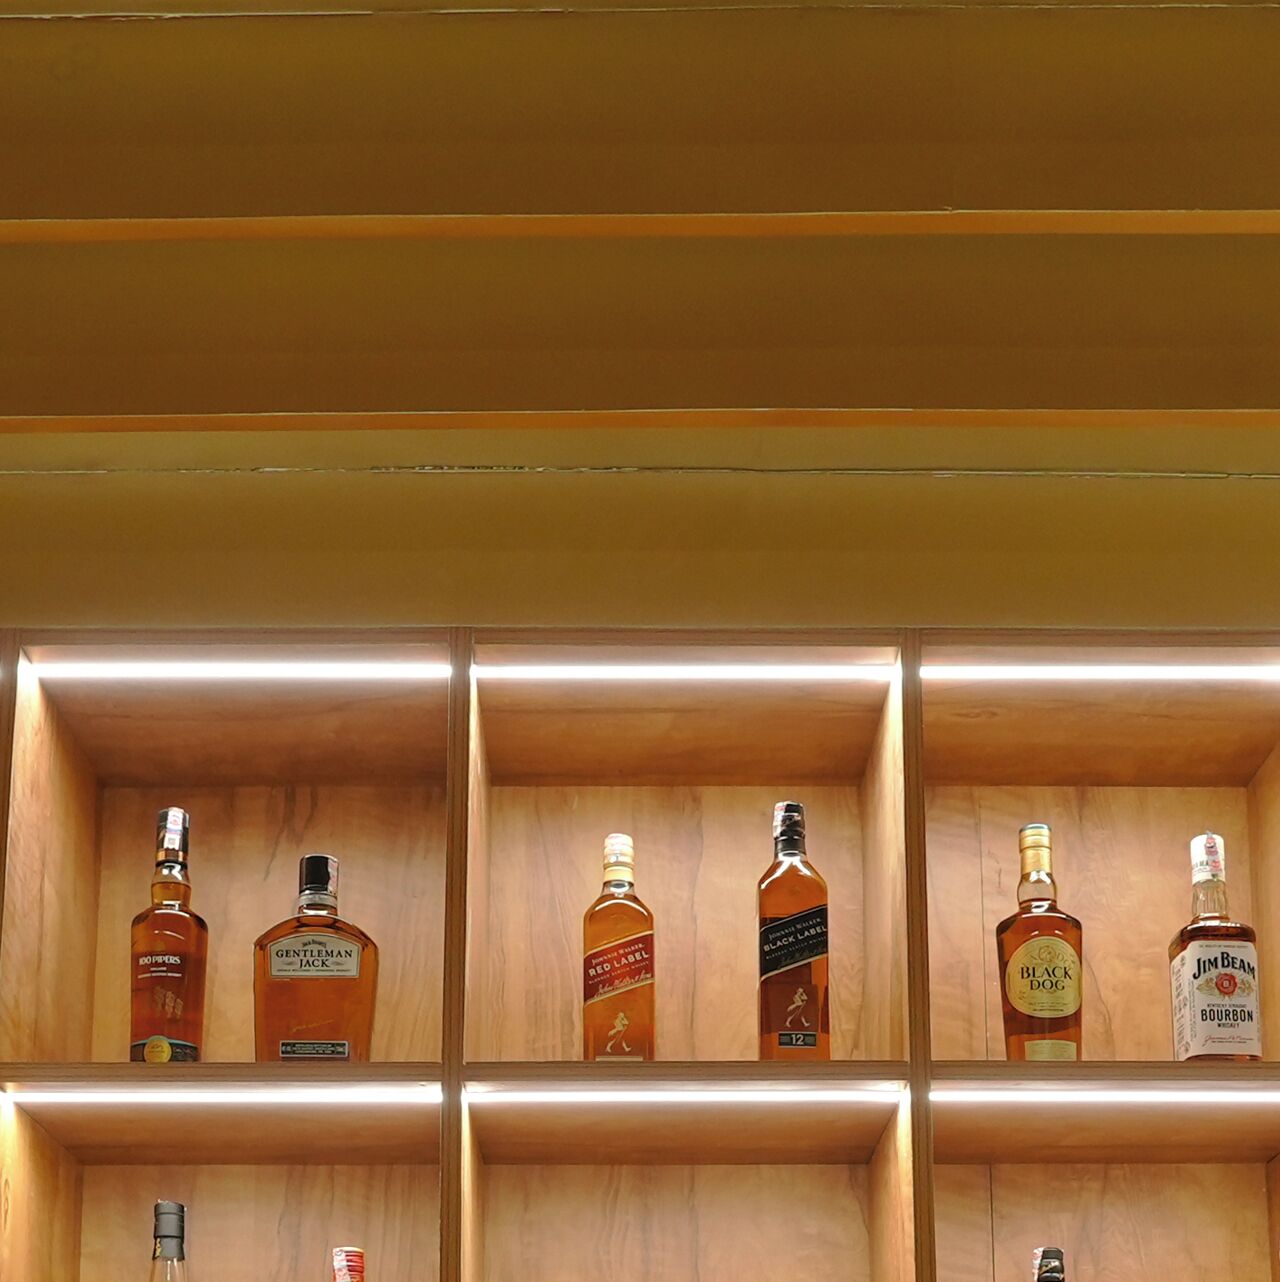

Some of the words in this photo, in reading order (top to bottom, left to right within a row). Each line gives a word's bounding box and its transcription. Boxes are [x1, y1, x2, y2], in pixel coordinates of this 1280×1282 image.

[762, 935, 796, 953] BLACK
[796, 924, 828, 941] LABEL
[275, 948, 354, 959] GENTLEMAN
[299, 958, 331, 969] JACK
[588, 962, 612, 978] RED
[613, 949, 650, 969] LABEL
[1192, 957, 1219, 980] JIM
[1220, 951, 1256, 981] BEAM
[1020, 965, 1073, 981] BLACK
[1029, 978, 1066, 992] DOG
[1200, 1008, 1254, 1023] BOURBON
[790, 1033, 805, 1046] 12
